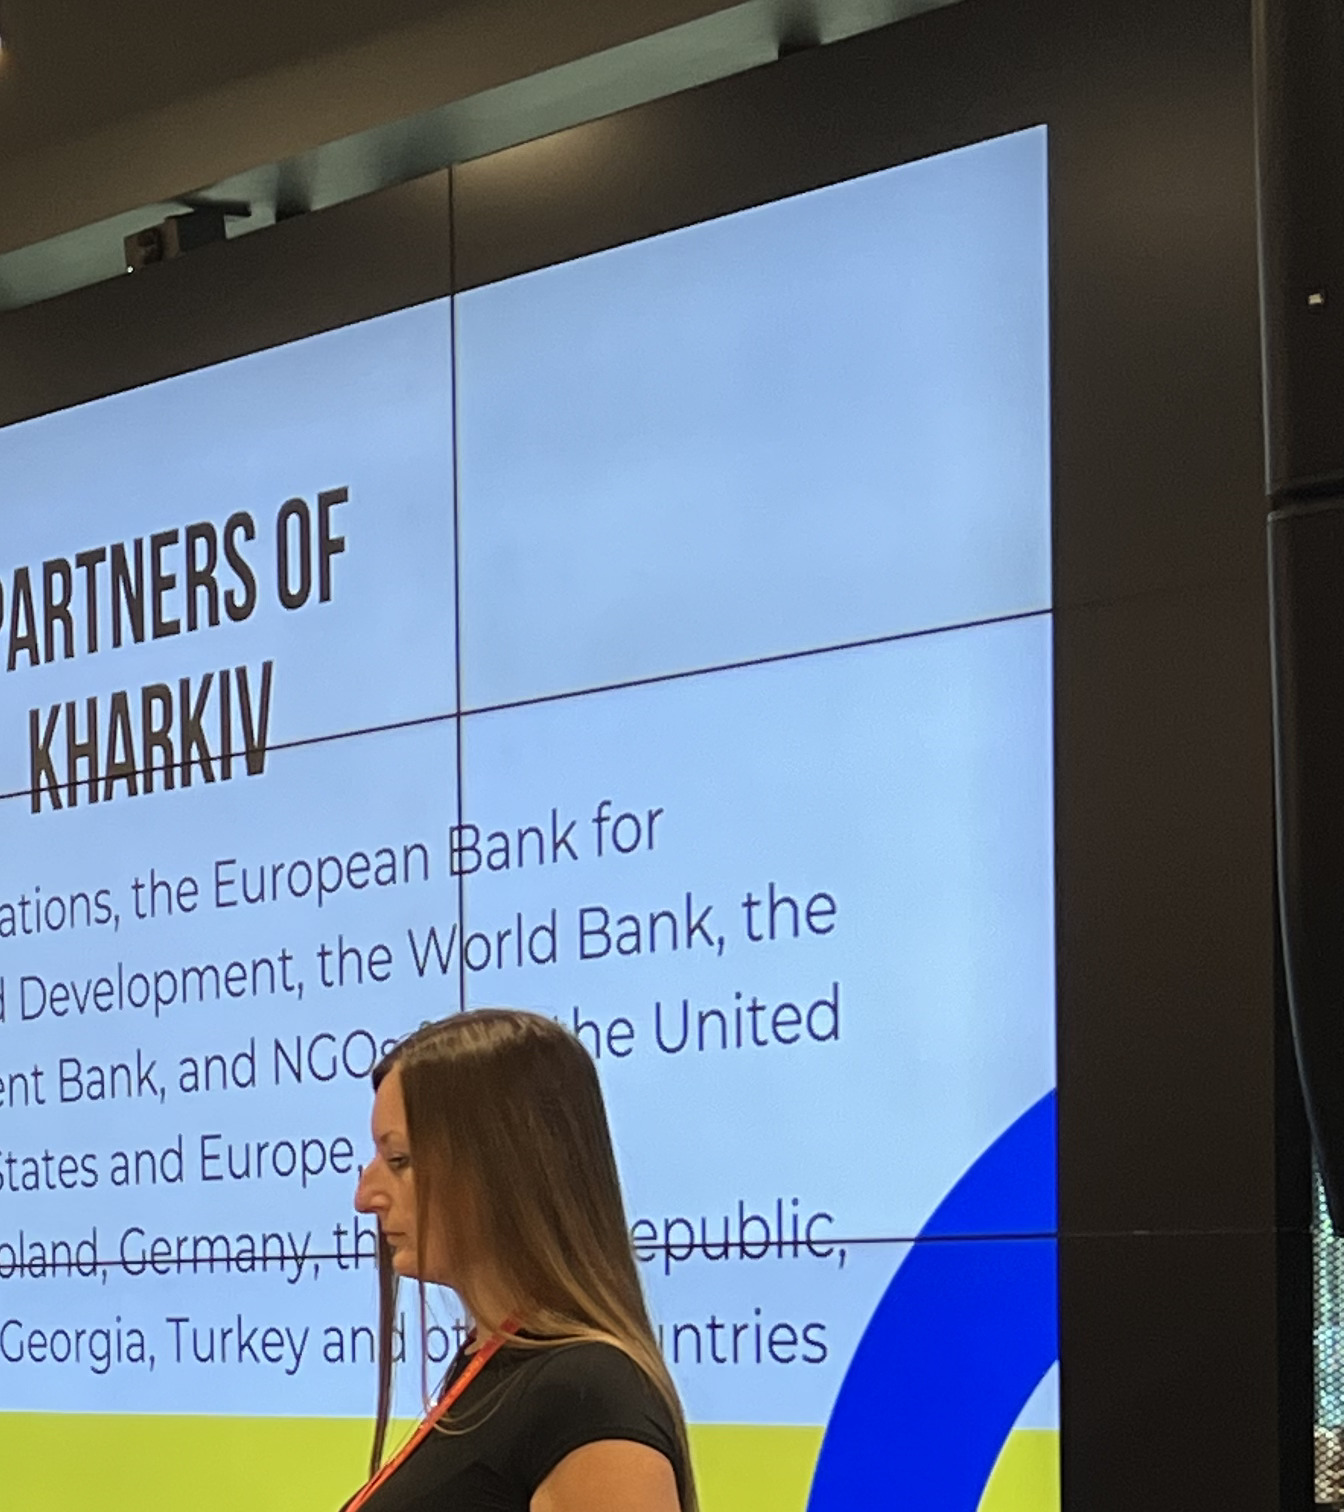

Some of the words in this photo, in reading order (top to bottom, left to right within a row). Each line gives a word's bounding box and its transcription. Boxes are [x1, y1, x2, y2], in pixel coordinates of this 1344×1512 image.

[275, 485, 350, 612] OF
[28, 659, 274, 815] KHARKIV
[133, 868, 200, 920] the
[214, 840, 430, 909] European
[449, 808, 578, 878] Bank
[592, 800, 664, 857] for
[20, 945, 305, 1021] Development,
[317, 934, 394, 989] the
[409, 908, 559, 979] World
[578, 891, 727, 961] Bank,
[741, 882, 839, 943] the
[58, 1047, 168, 1105] Bank,
[178, 1038, 257, 1095] and
[557, 1005, 635, 1060] he
[654, 981, 841, 1055] United
[110, 1133, 184, 1188] and
[120, 1223, 320, 1286] Germany,
[332, 1214, 378, 1270] th
[631, 1197, 846, 1277] epublic,
[0, 1314, 157, 1375] Georgia,
[165, 1312, 310, 1376] Turkey
[323, 1311, 406, 1364] and
[659, 1306, 829, 1365] ntries
